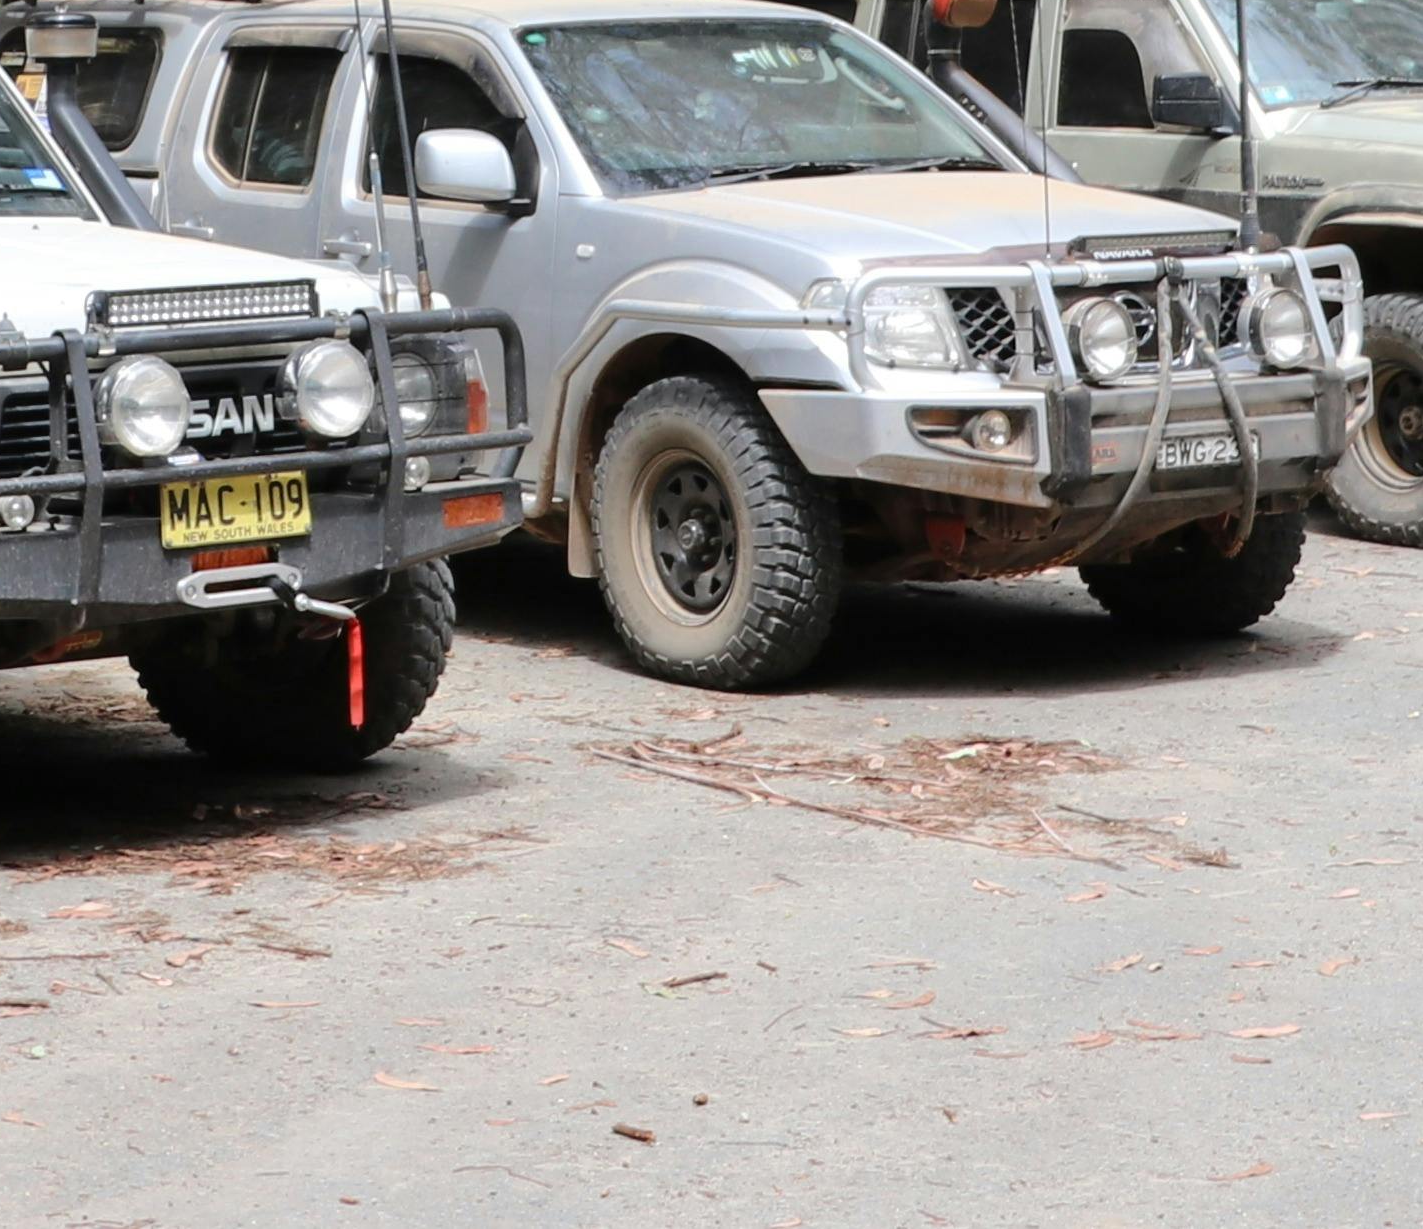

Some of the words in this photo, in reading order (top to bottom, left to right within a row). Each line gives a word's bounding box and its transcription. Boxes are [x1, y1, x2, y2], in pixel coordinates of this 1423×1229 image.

[186, 394, 275, 439] SAN
[183, 530, 208, 543] NEW
[214, 526, 252, 540] SOUTH
[257, 521, 294, 535] WALES
